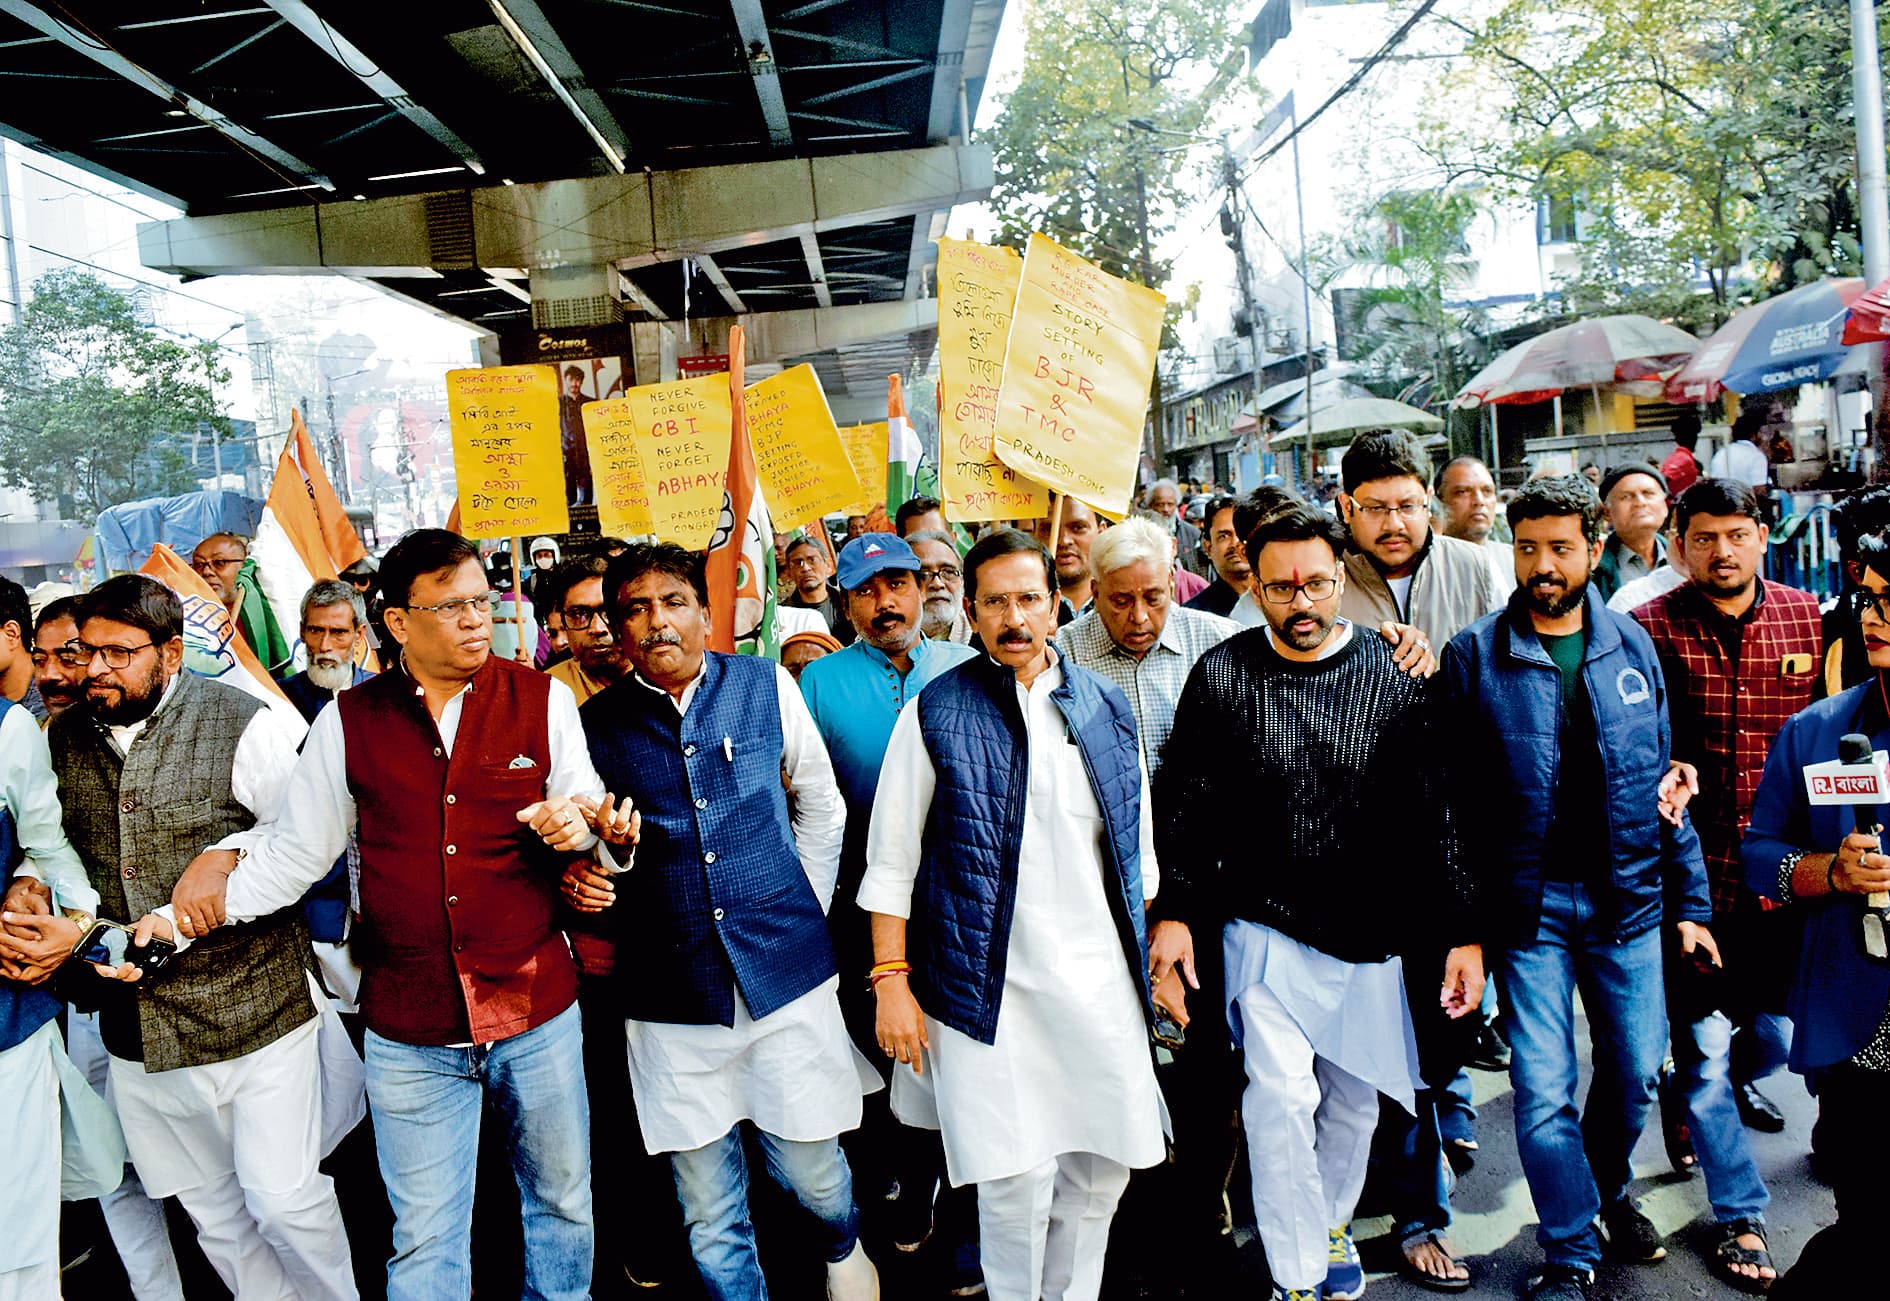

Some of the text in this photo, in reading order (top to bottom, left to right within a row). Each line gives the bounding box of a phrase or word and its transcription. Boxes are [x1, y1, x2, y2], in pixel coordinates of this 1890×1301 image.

[1051, 263, 1095, 293] MURDER
[1052, 303, 1104, 336] STORY
[1063, 325, 1080, 336] OF
[1043, 327, 1104, 366] SETTING
[1060, 352, 1076, 363] OF
[650, 387, 694, 401] NEVER
[652, 400, 706, 416] FORGIVE
[747, 402, 789, 425] BHAYA
[1049, 394, 1068, 416] &
[756, 418, 784, 433] TMC
[1020, 404, 1076, 442] TMC
[757, 430, 782, 448] BJP
[657, 441, 704, 456] NEVER
[758, 441, 798, 461] SETTING
[658, 454, 712, 471] FORGET
[760, 451, 801, 472] EXPOSED
[771, 459, 808, 479] JUSTICE
[1013, 439, 1105, 495] PRADESH CONG
[772, 471, 804, 489] DENIED
[674, 521, 717, 534] CONGRE
[1835, 776, 1875, 792] বাংলা
